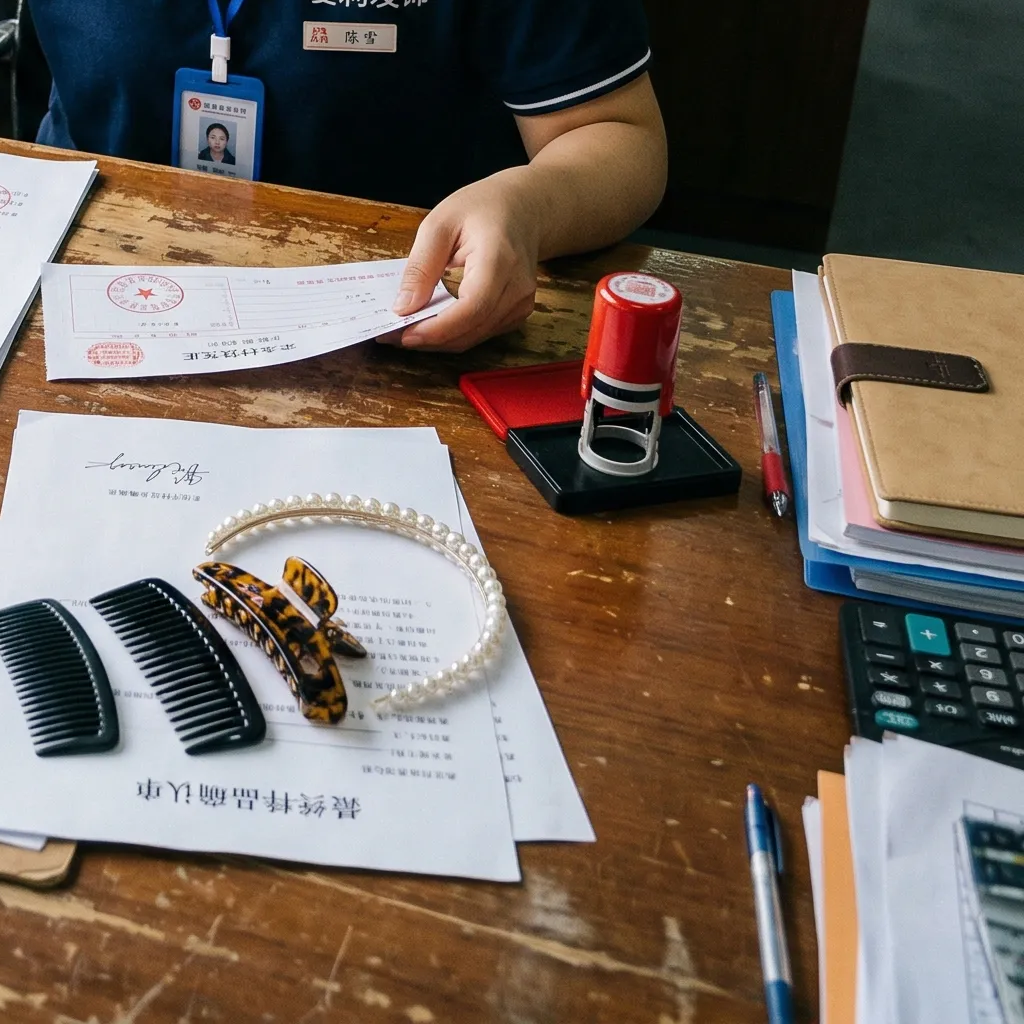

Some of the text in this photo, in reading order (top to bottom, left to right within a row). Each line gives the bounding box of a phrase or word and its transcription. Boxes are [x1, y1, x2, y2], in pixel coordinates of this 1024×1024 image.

[135, 777, 362, 820] 最终样品确认单
